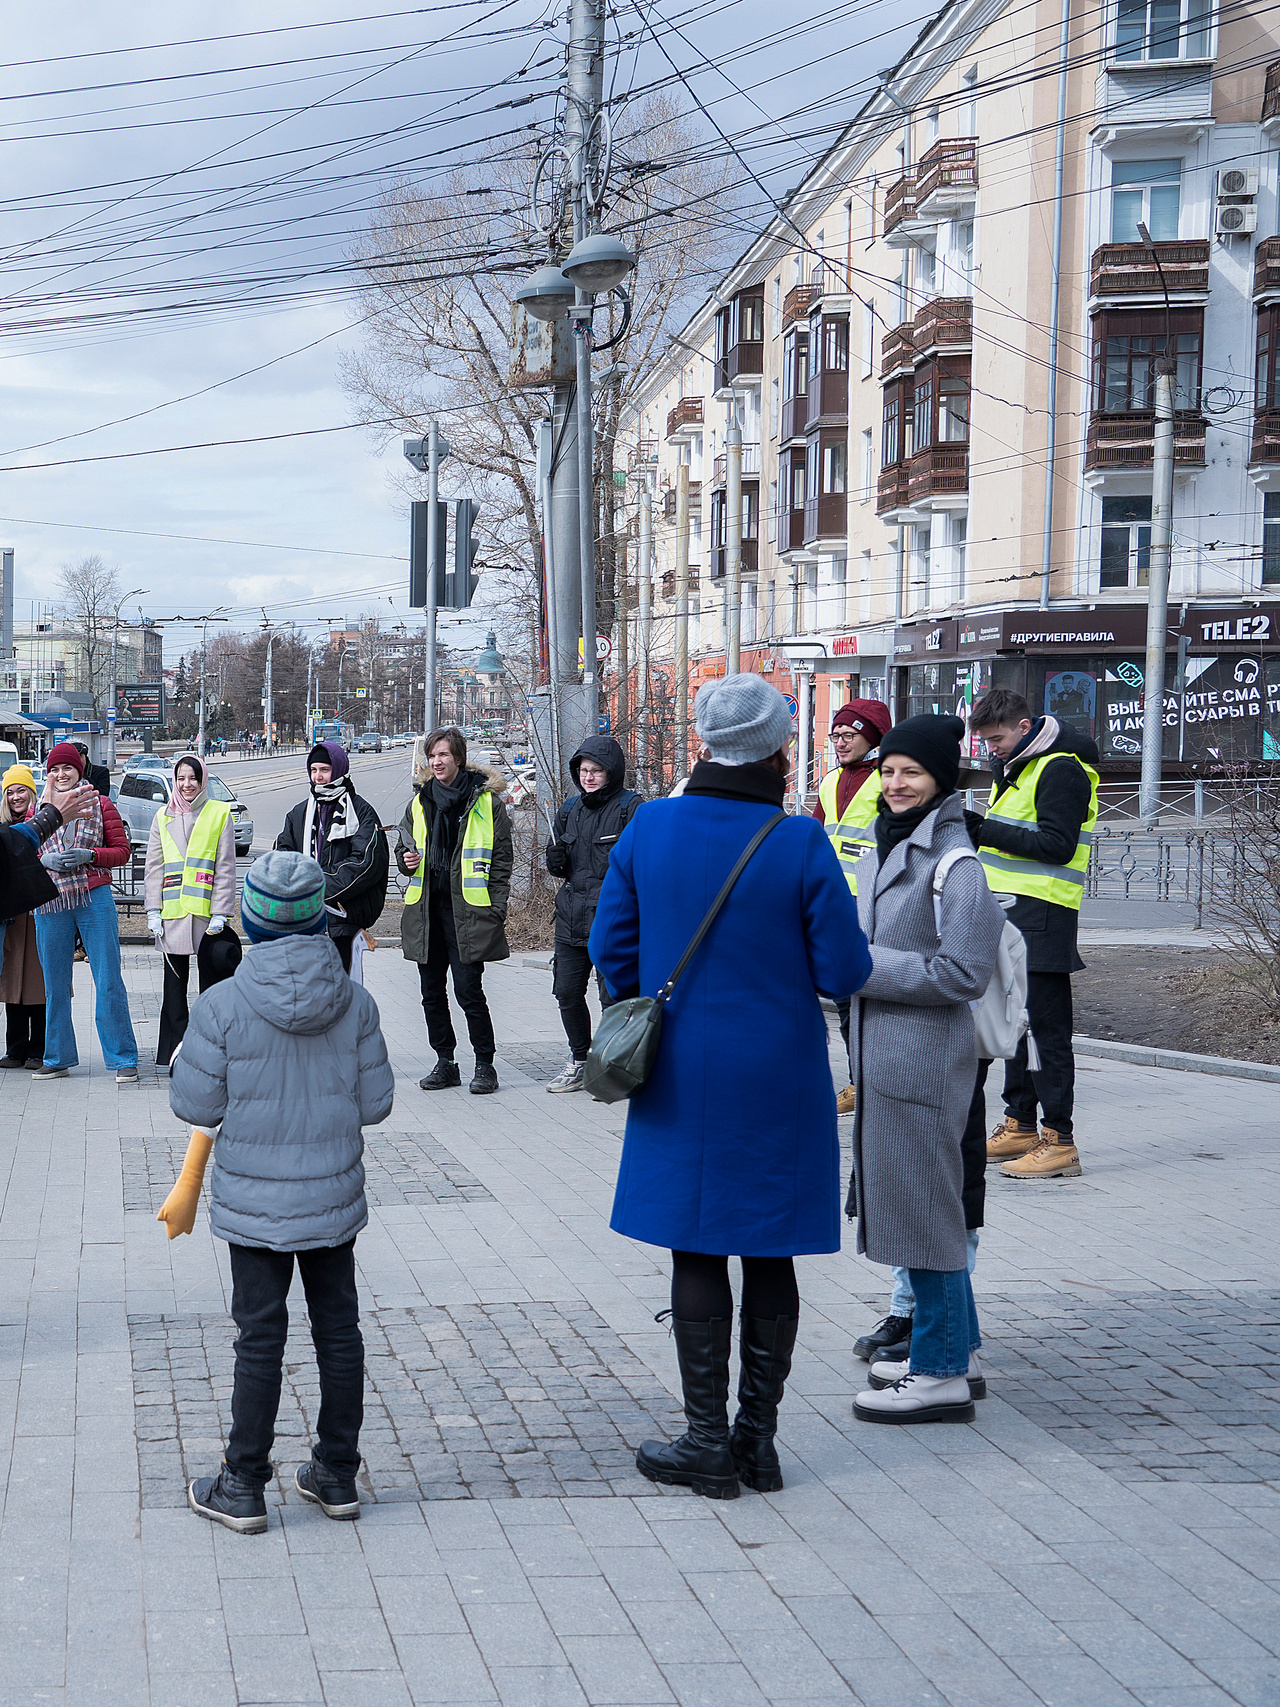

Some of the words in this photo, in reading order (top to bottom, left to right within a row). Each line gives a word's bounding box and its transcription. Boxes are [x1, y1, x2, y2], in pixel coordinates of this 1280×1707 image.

[1200, 615, 1270, 640] TELE2
[1010, 632, 1115, 644] #ДРУГИЕПРАВИЛА
[1248, 702, 1260, 716] В
[293, 882, 326, 920] BE
